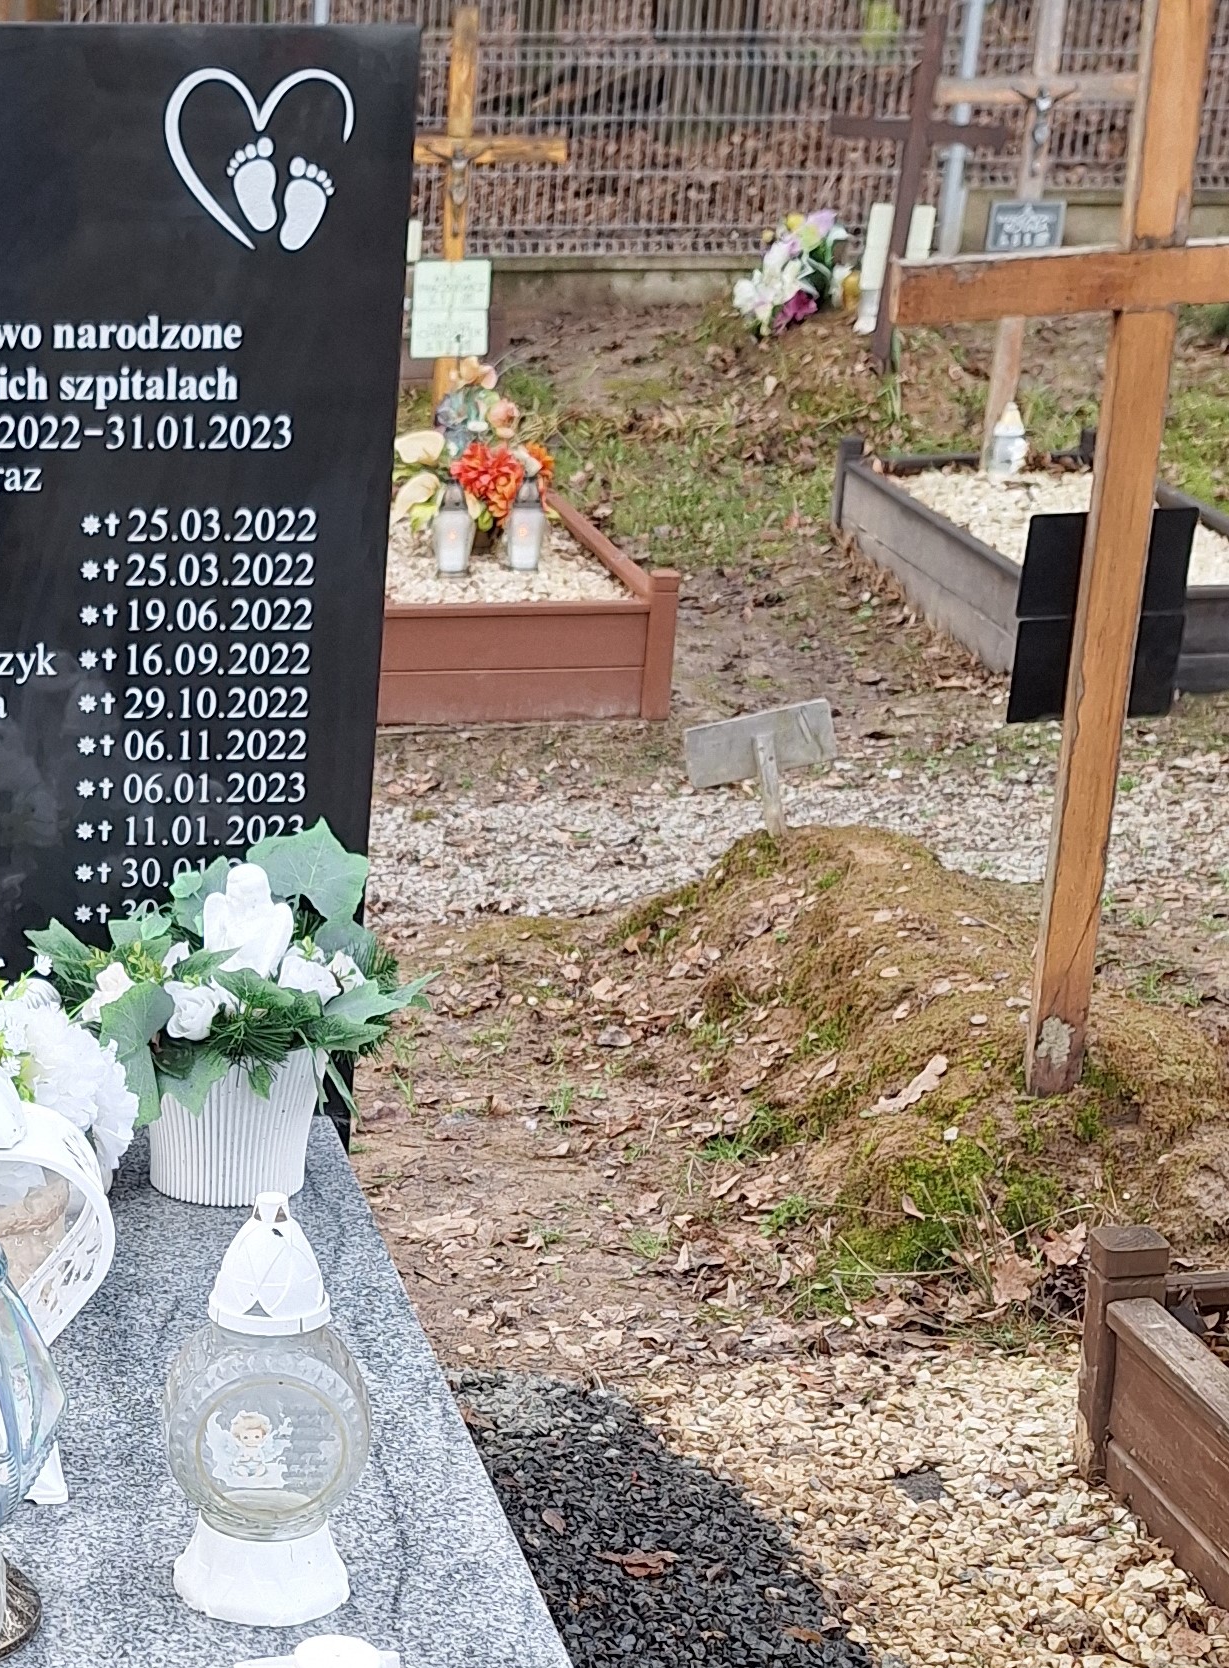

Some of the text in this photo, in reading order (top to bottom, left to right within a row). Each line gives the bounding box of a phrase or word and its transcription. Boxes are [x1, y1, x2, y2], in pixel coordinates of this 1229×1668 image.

[53, 315, 243, 350] narodzone
[59, 365, 238, 410] szpitalach
[127, 507, 317, 542] 25.03.2022
[125, 552, 315, 587] 25.03.2022
[128, 597, 313, 632] 19.06.2022
[127, 642, 310, 676] 16.09.2022
[123, 686, 309, 719] 29.10.2022
[124, 728, 307, 761] 06.11.2022
[123, 771, 306, 804] 06.01.2023
